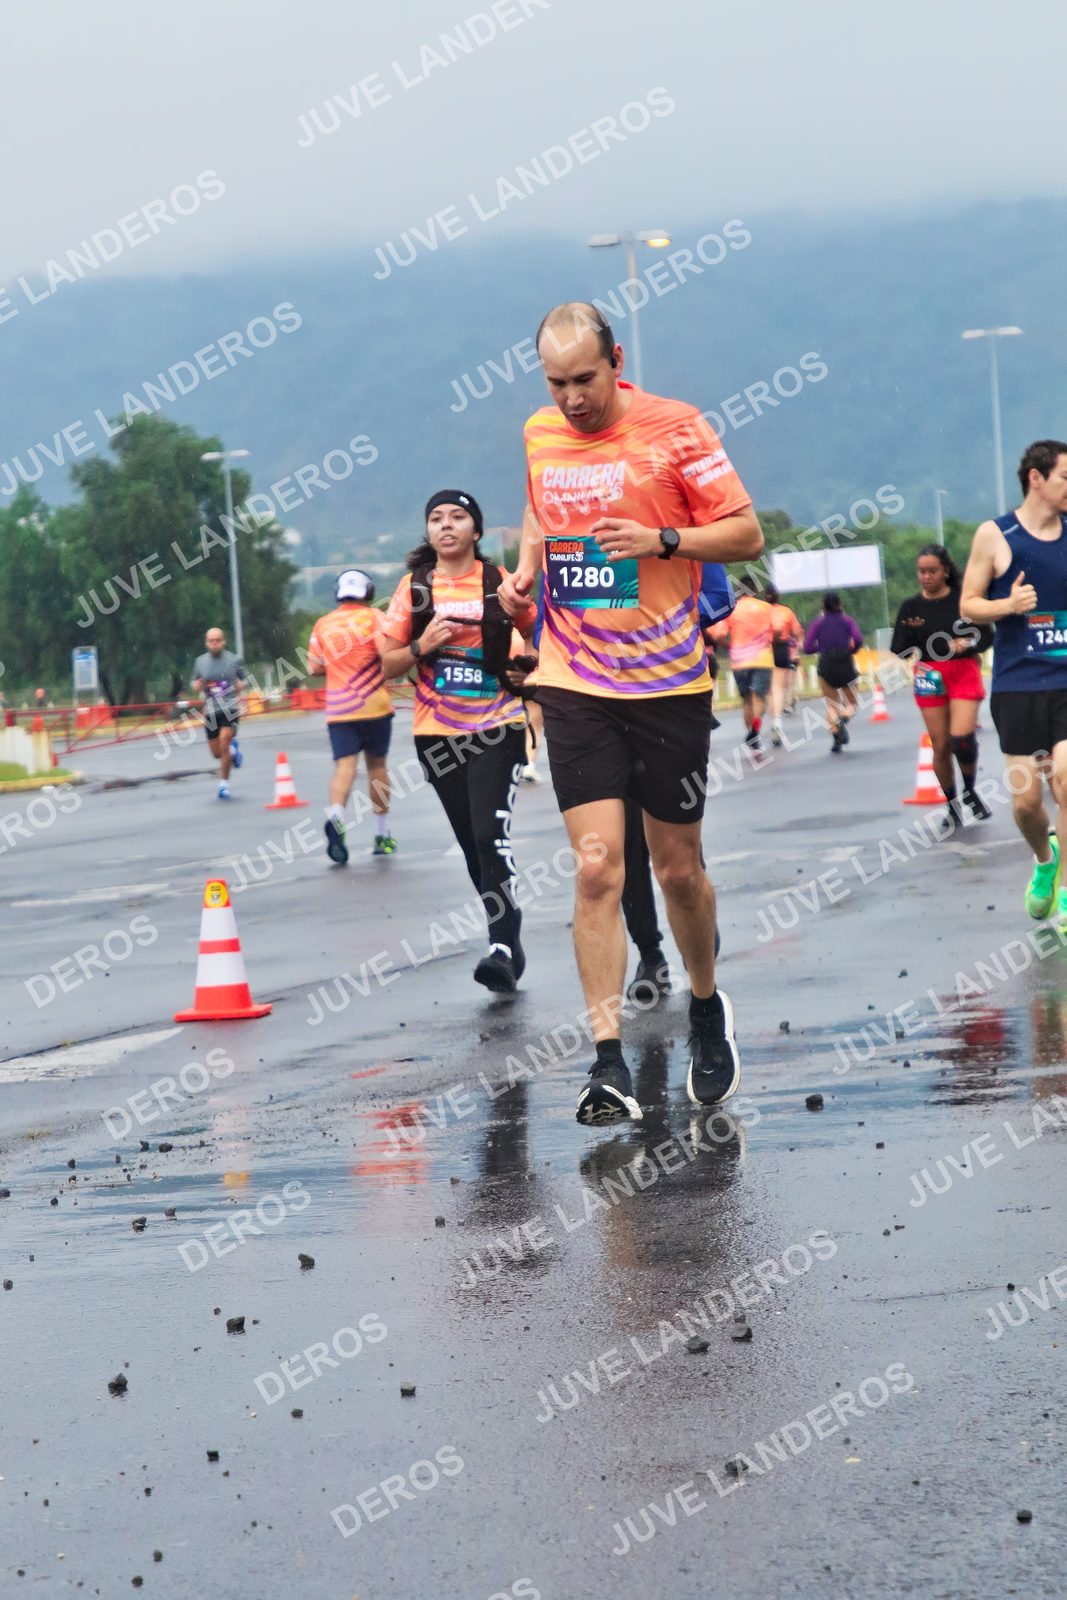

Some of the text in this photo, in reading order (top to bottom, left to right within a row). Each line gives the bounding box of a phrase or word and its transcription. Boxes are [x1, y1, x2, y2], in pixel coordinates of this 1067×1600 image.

[543, 460, 625, 488] CARRERA
[550, 542, 584, 553] CARRERA
[559, 566, 615, 588] 1280
[443, 666, 483, 683] 1558
